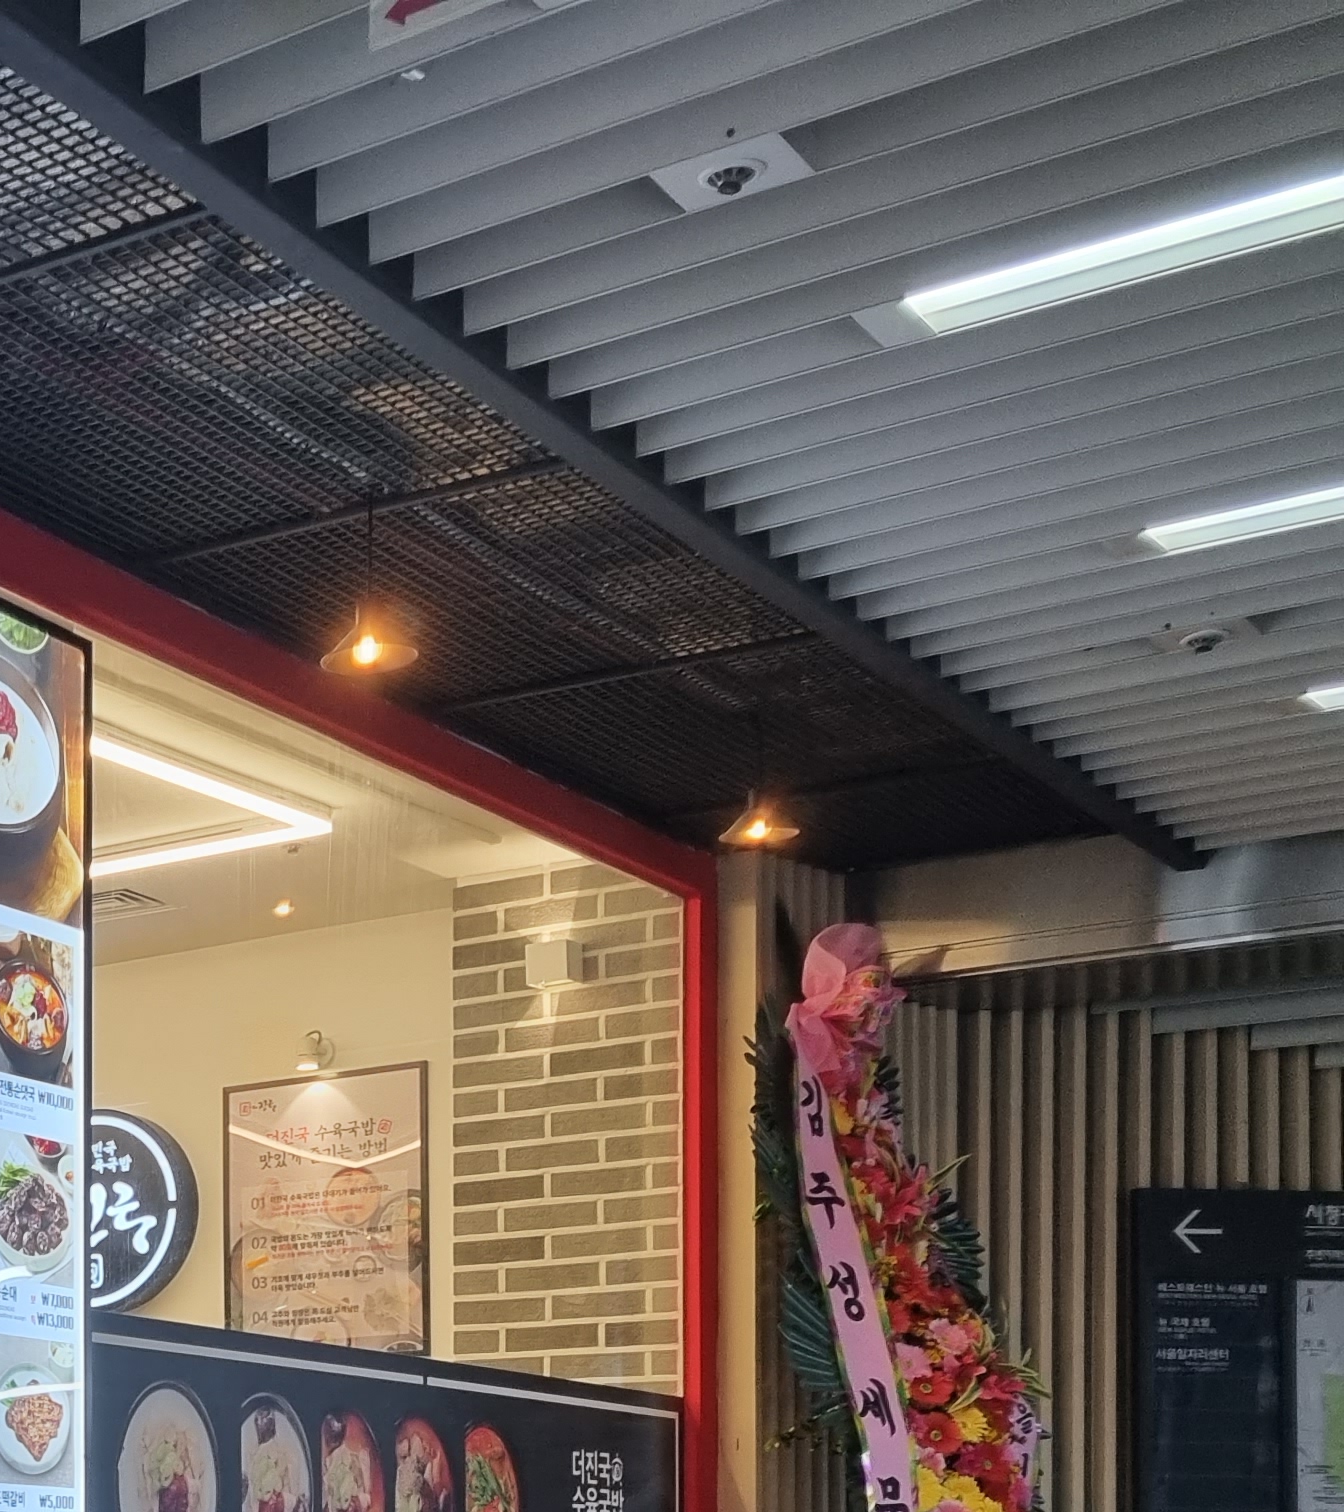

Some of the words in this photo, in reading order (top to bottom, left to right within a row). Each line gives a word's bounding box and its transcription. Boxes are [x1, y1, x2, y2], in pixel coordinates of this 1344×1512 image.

[37, 1089, 74, 1112] ₩10,000
[314, 1117, 376, 1142] 수육국밥
[251, 1197, 266, 1211] 01
[251, 1236, 268, 1250] 02
[251, 1276, 268, 1290] 03
[41, 1291, 74, 1310] ₩7,000
[37, 1311, 74, 1331] ₩13,000
[252, 1310, 269, 1325] 04
[572, 1449, 612, 1487] 더진국
[39, 1494, 74, 1512] ₩5,000
